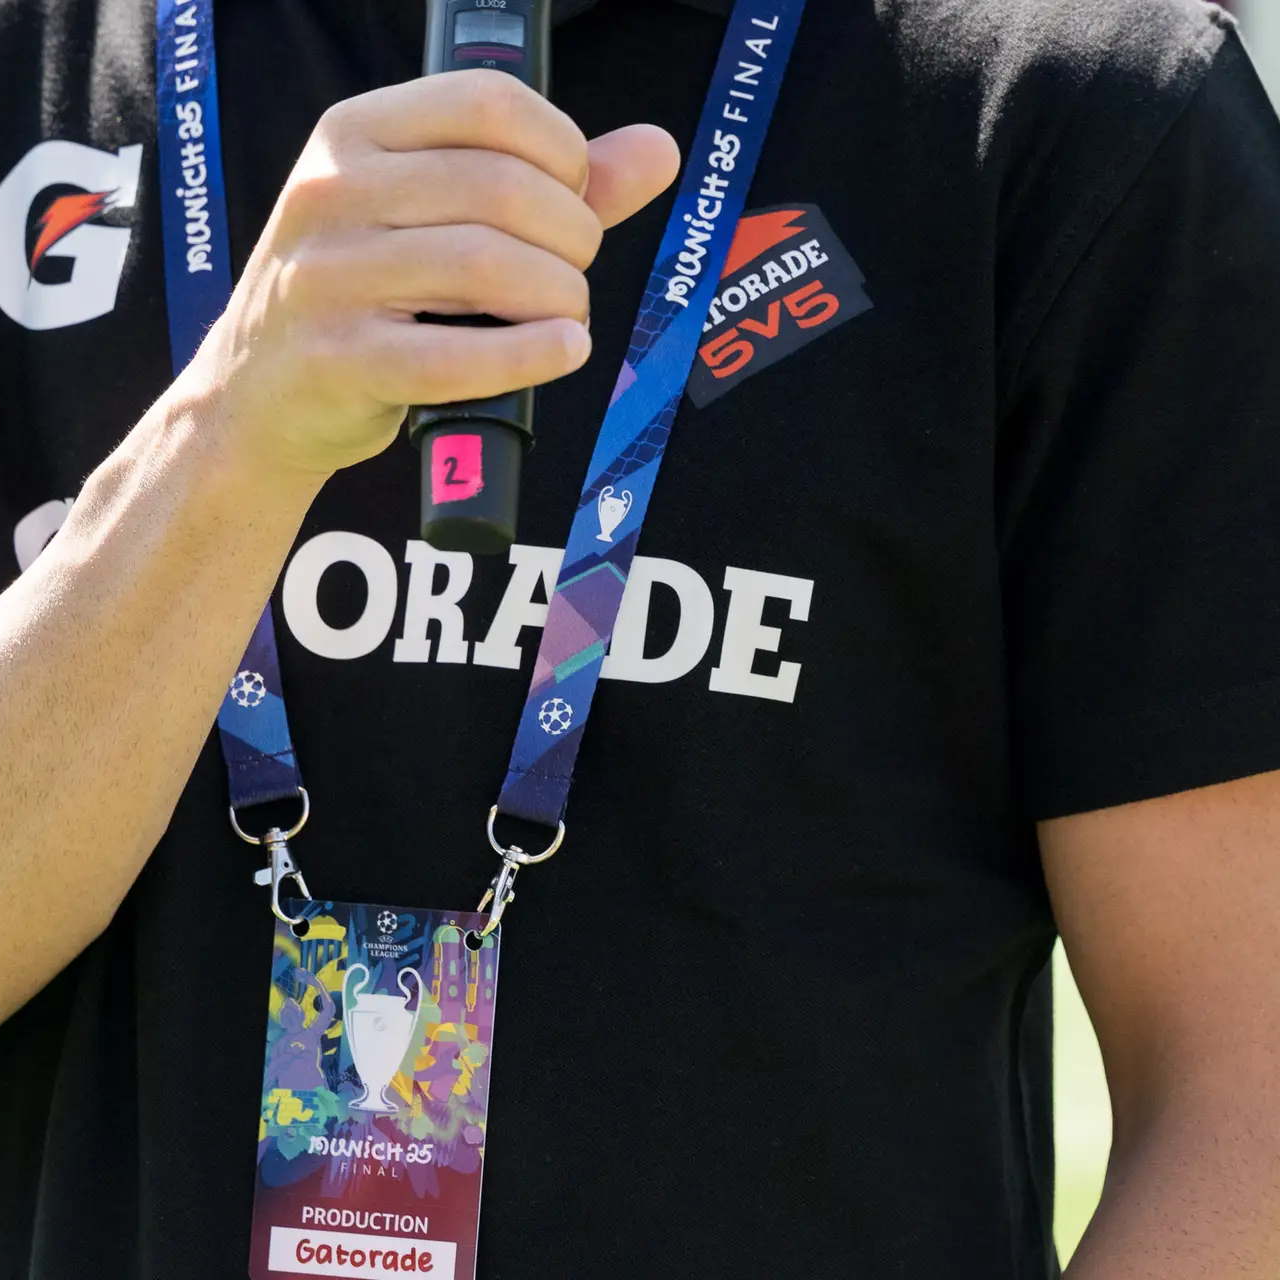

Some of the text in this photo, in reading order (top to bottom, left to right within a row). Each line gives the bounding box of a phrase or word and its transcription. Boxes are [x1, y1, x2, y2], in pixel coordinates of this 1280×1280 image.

[723, 15, 780, 123] FINAL
[701, 238, 830, 333] TORADE
[443, 456, 470, 486] 2
[362, 942, 409, 952] CHAMPIONS
[370, 950, 401, 959] LEAGUE
[405, 1143, 434, 1165] 25
[340, 1162, 399, 1178] FINAL
[301, 1206, 429, 1234] PRODUCTION
[295, 1238, 434, 1273] Gatorade
